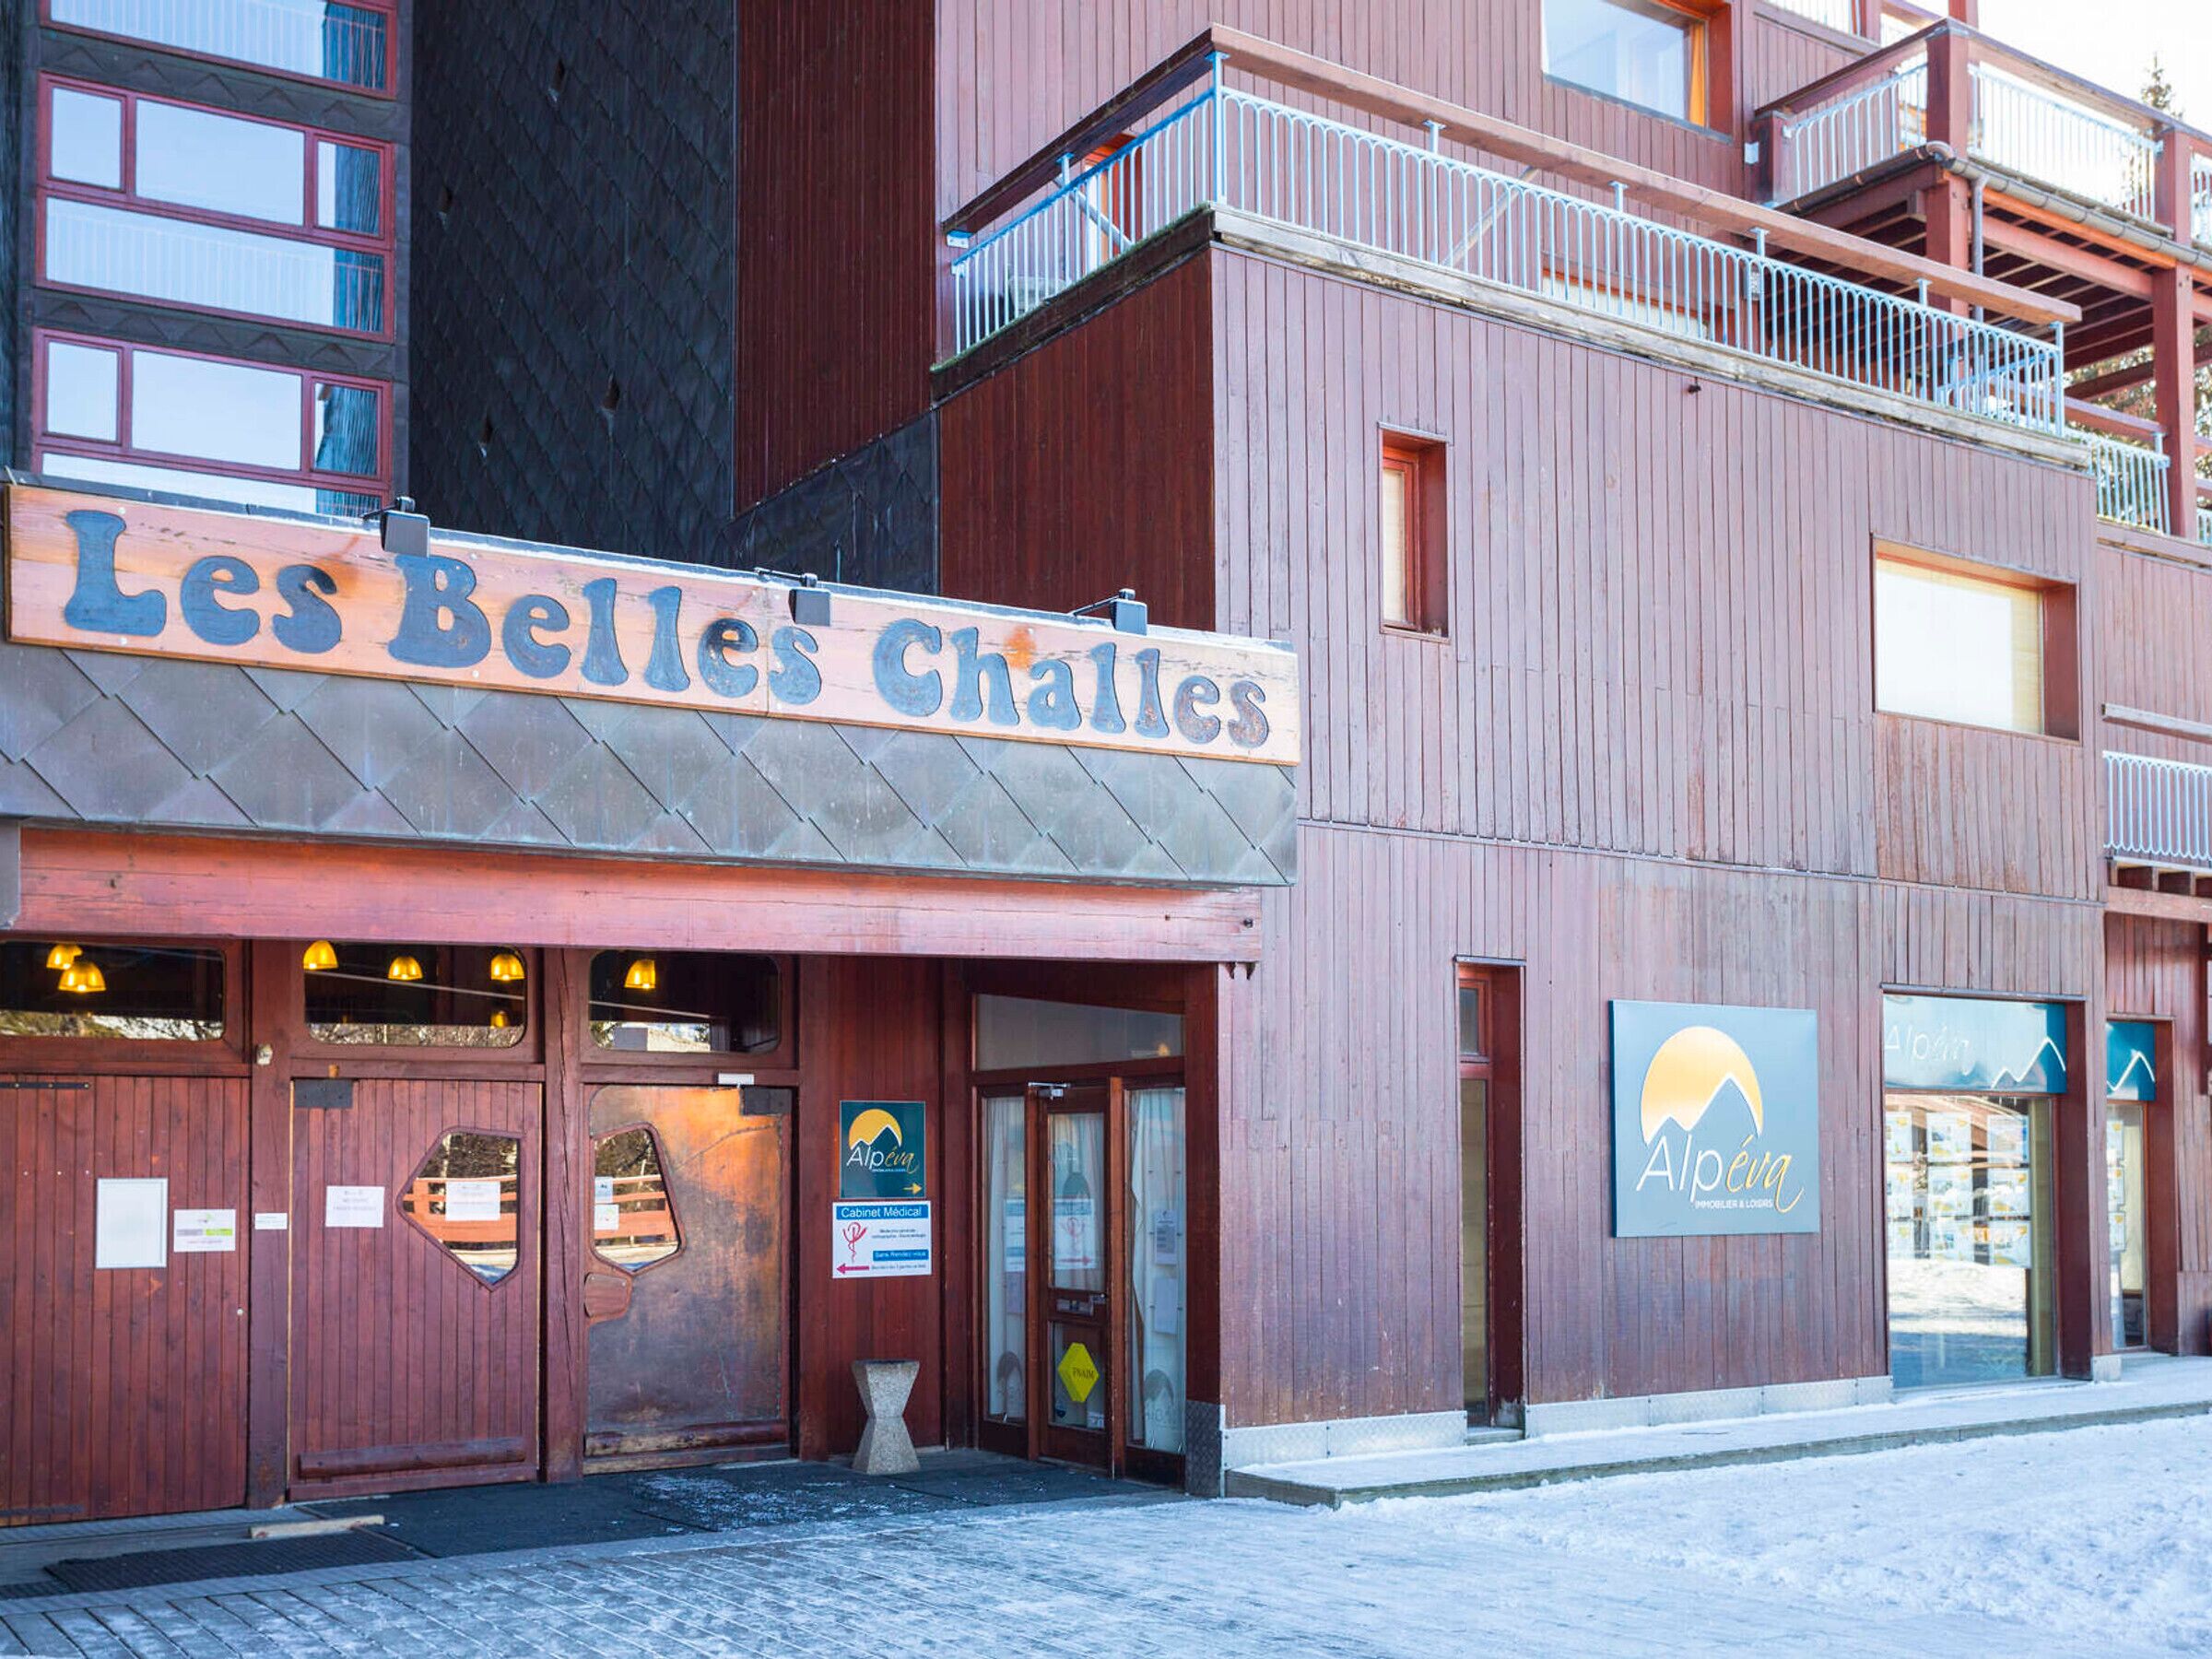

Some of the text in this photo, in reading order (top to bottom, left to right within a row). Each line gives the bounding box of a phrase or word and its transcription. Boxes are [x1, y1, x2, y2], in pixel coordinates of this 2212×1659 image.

[64, 509, 1270, 748] Les Belles Challes
[846, 1146, 920, 1174] Alpéva
[1636, 1134, 1805, 1213] Alpéva
[841, 1206, 922, 1218] Cabinet Médical
